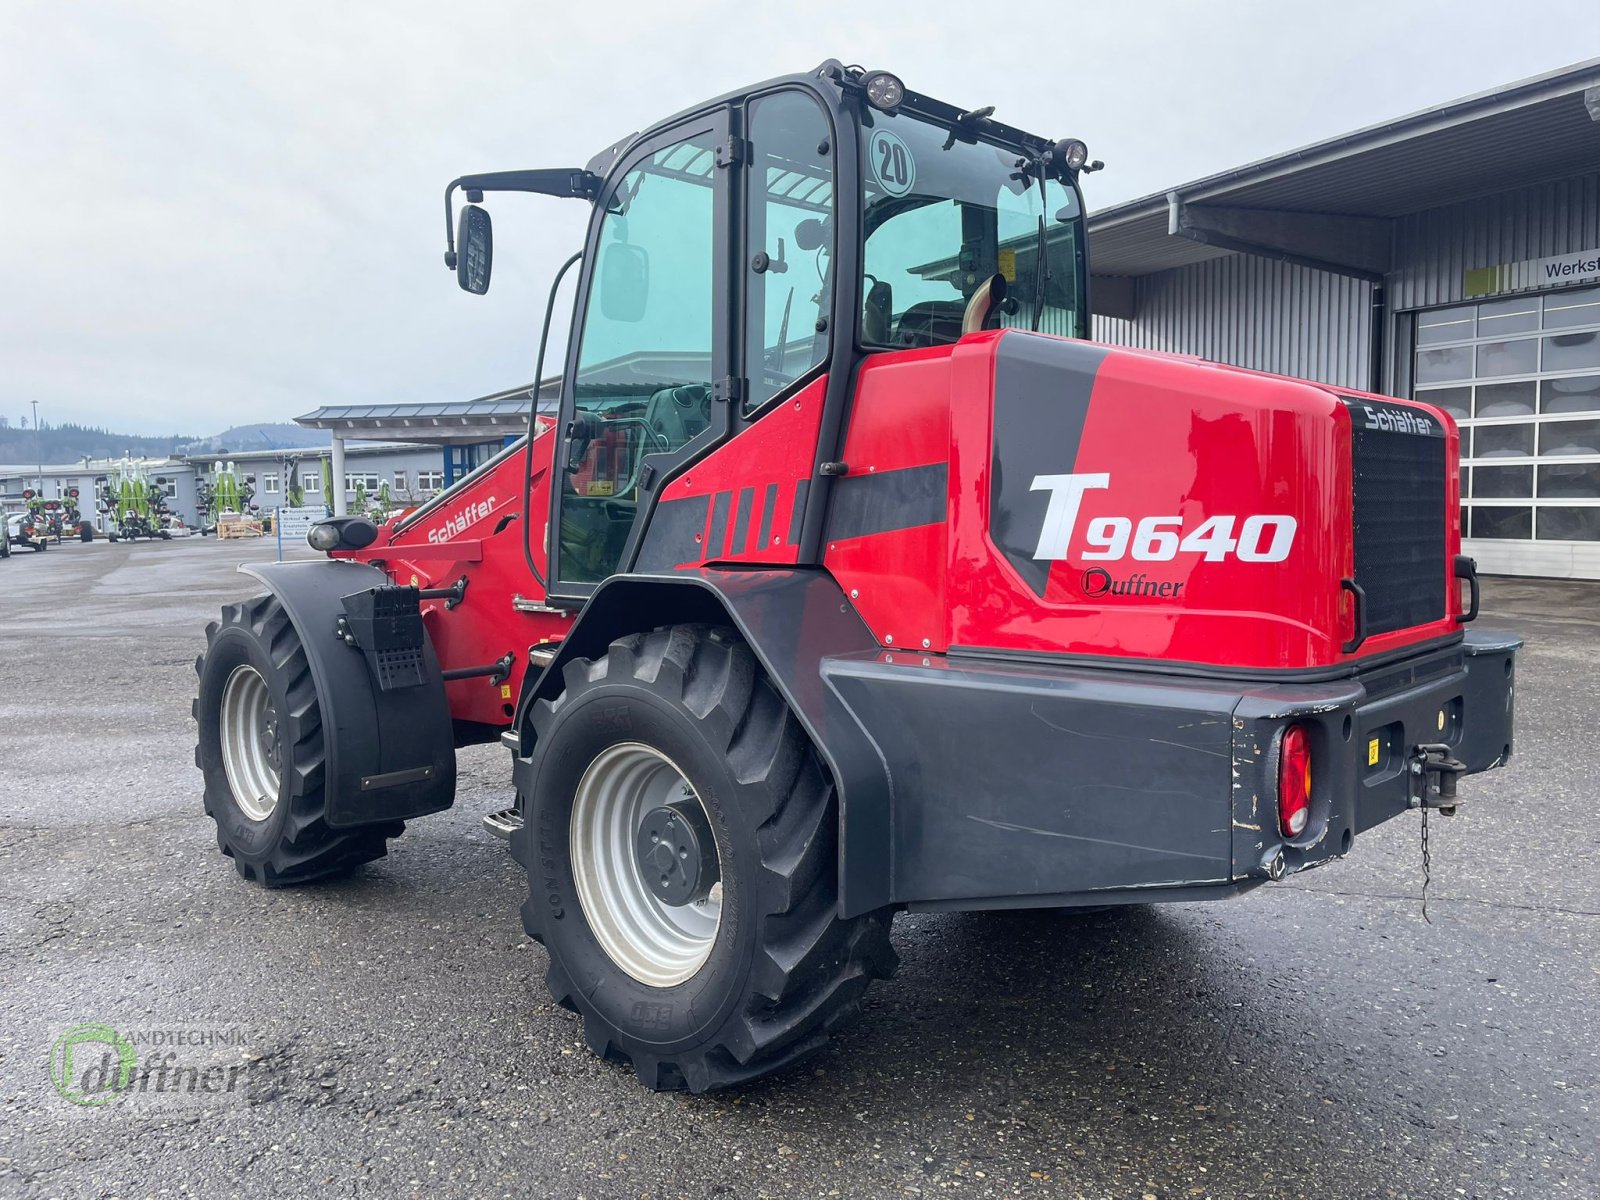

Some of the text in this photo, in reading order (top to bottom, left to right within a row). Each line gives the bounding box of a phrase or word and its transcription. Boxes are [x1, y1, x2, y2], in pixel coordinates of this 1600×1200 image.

[878, 139, 908, 186] 20
[1363, 406, 1433, 435] Schäffer
[428, 496, 496, 543] Schäffer
[1081, 567, 1185, 599] Duffner
